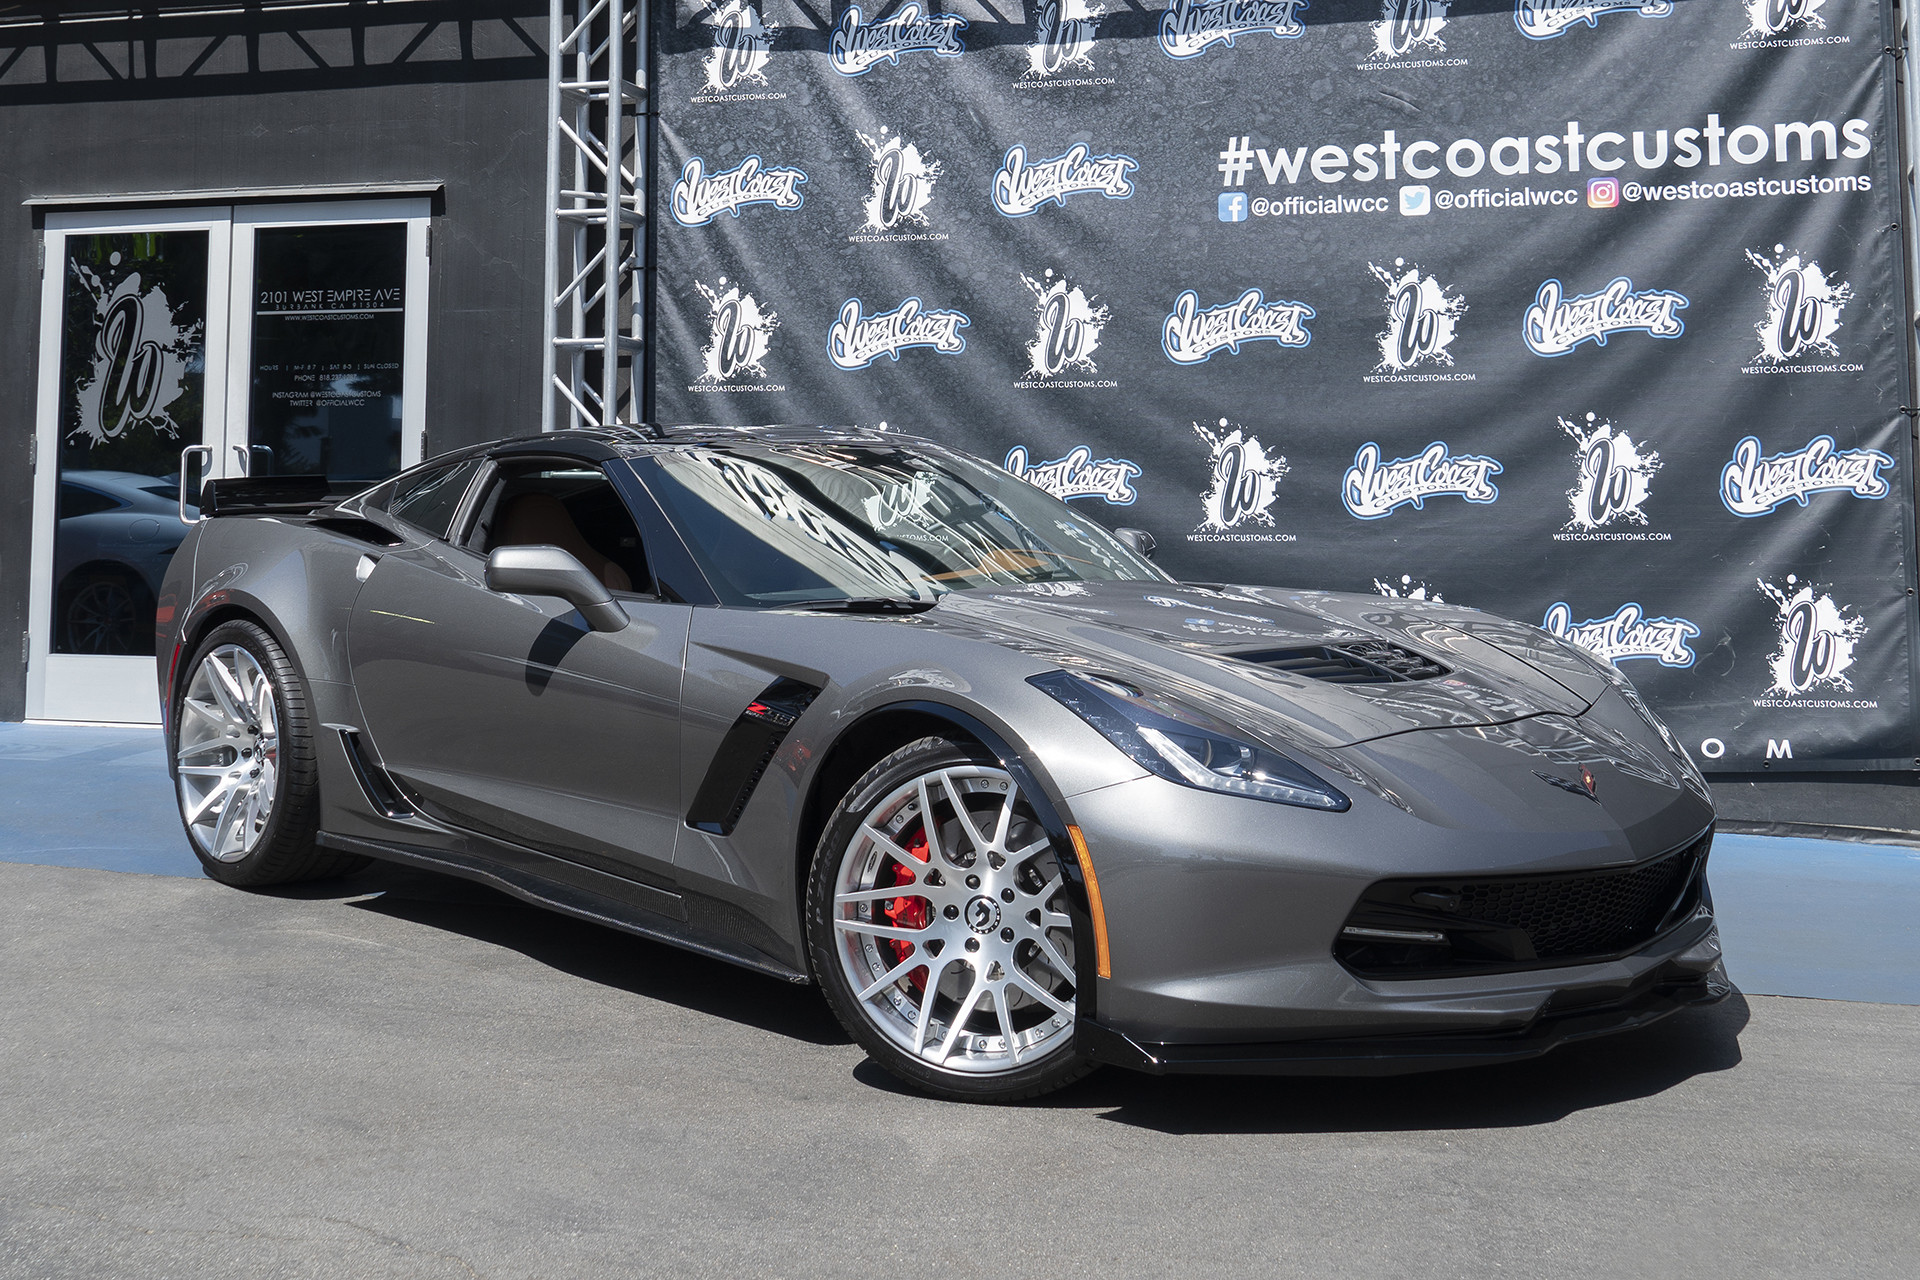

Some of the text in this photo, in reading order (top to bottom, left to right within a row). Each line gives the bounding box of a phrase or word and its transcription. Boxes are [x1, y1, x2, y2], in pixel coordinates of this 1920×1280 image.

[1730, 36, 1850, 50] WESTCOASTCUSTOMS.COM
[1357, 58, 1468, 70] WESTCOASTCUSTOMS.COM
[1012, 78, 1115, 90] WESTCOASTCUSTOMS.COM
[690, 92, 787, 103] WESTCOASTCUSTOMS.COM
[1218, 113, 1872, 186] #westcoastcustoms
[1251, 193, 1389, 217] @officialwcc
[1434, 186, 1579, 210] @officialwcc
[1622, 171, 1872, 203] @westcoastcustoms
[848, 232, 949, 243] WESTCOASTCUSTOMS.COM
[260, 287, 401, 304] 2101 WEST EMPIRE AVE
[331, 302, 345, 310] CA
[284, 313, 375, 321] WWW.WESTCOASTCUSTOMS.COM
[1740, 363, 1863, 375] WESTCOASTCUSTOMS.COM
[294, 374, 315, 382] PHONE
[1363, 372, 1476, 383] WESTCOASTCUSTOMS.COM
[688, 383, 786, 393] WESTCOASTCUSTOMS.COM
[1013, 379, 1118, 390] WESTCOASTCUSTOMS.COM
[272, 390, 309, 399] INSTAGRAM
[289, 399, 365, 407] TWITTER @OFFICIALWCC
[1186, 533, 1297, 542] WESTCOASTCUSTOMS.COM
[1552, 532, 1672, 542] WESTCOASTCUSTOMS.COM
[1753, 698, 1878, 709] WESTCOASTCUSTOMS.COM
